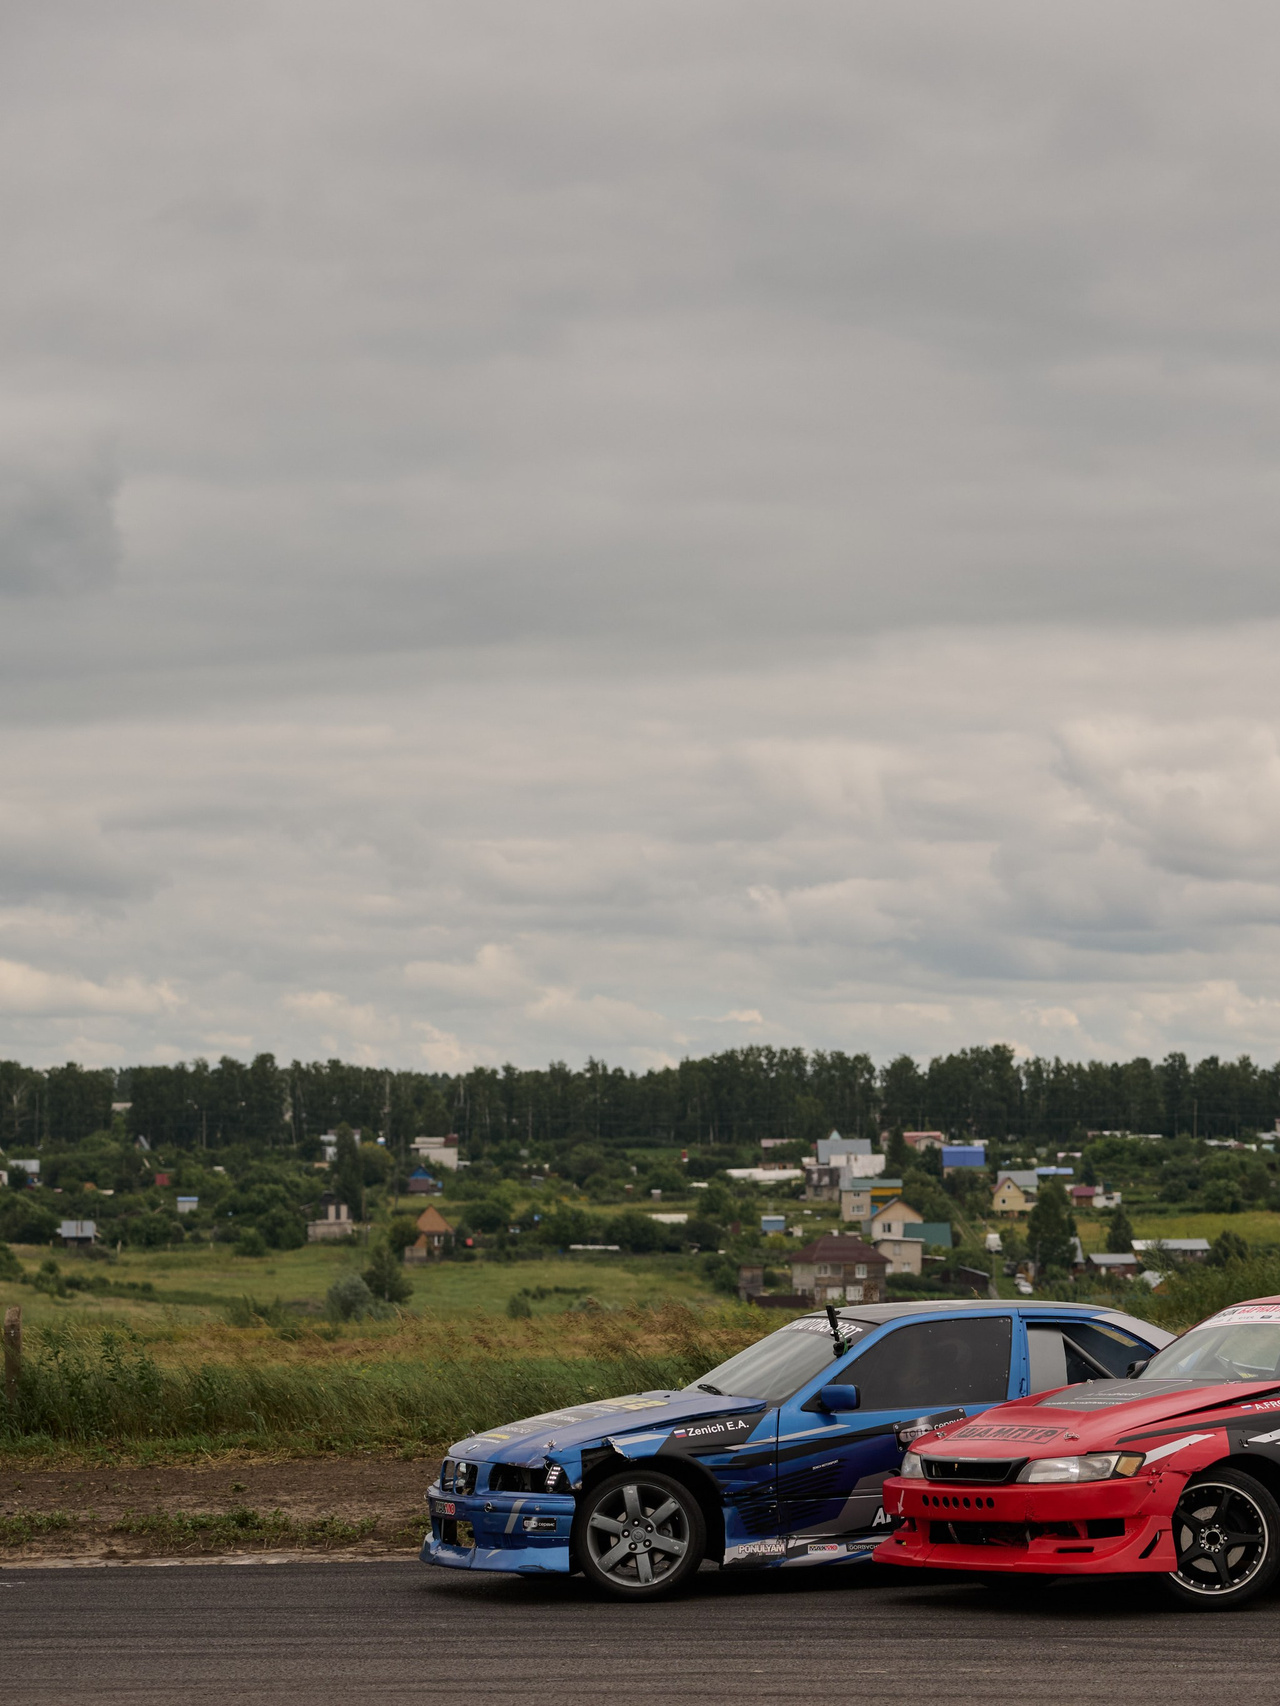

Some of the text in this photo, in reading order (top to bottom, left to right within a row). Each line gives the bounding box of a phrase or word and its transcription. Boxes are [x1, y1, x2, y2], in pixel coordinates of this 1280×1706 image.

[686, 1419, 750, 1437] Zenich E.A.
[955, 1426, 1059, 1441] ШАМПУР
[739, 1543, 785, 1554] PONULYAM
